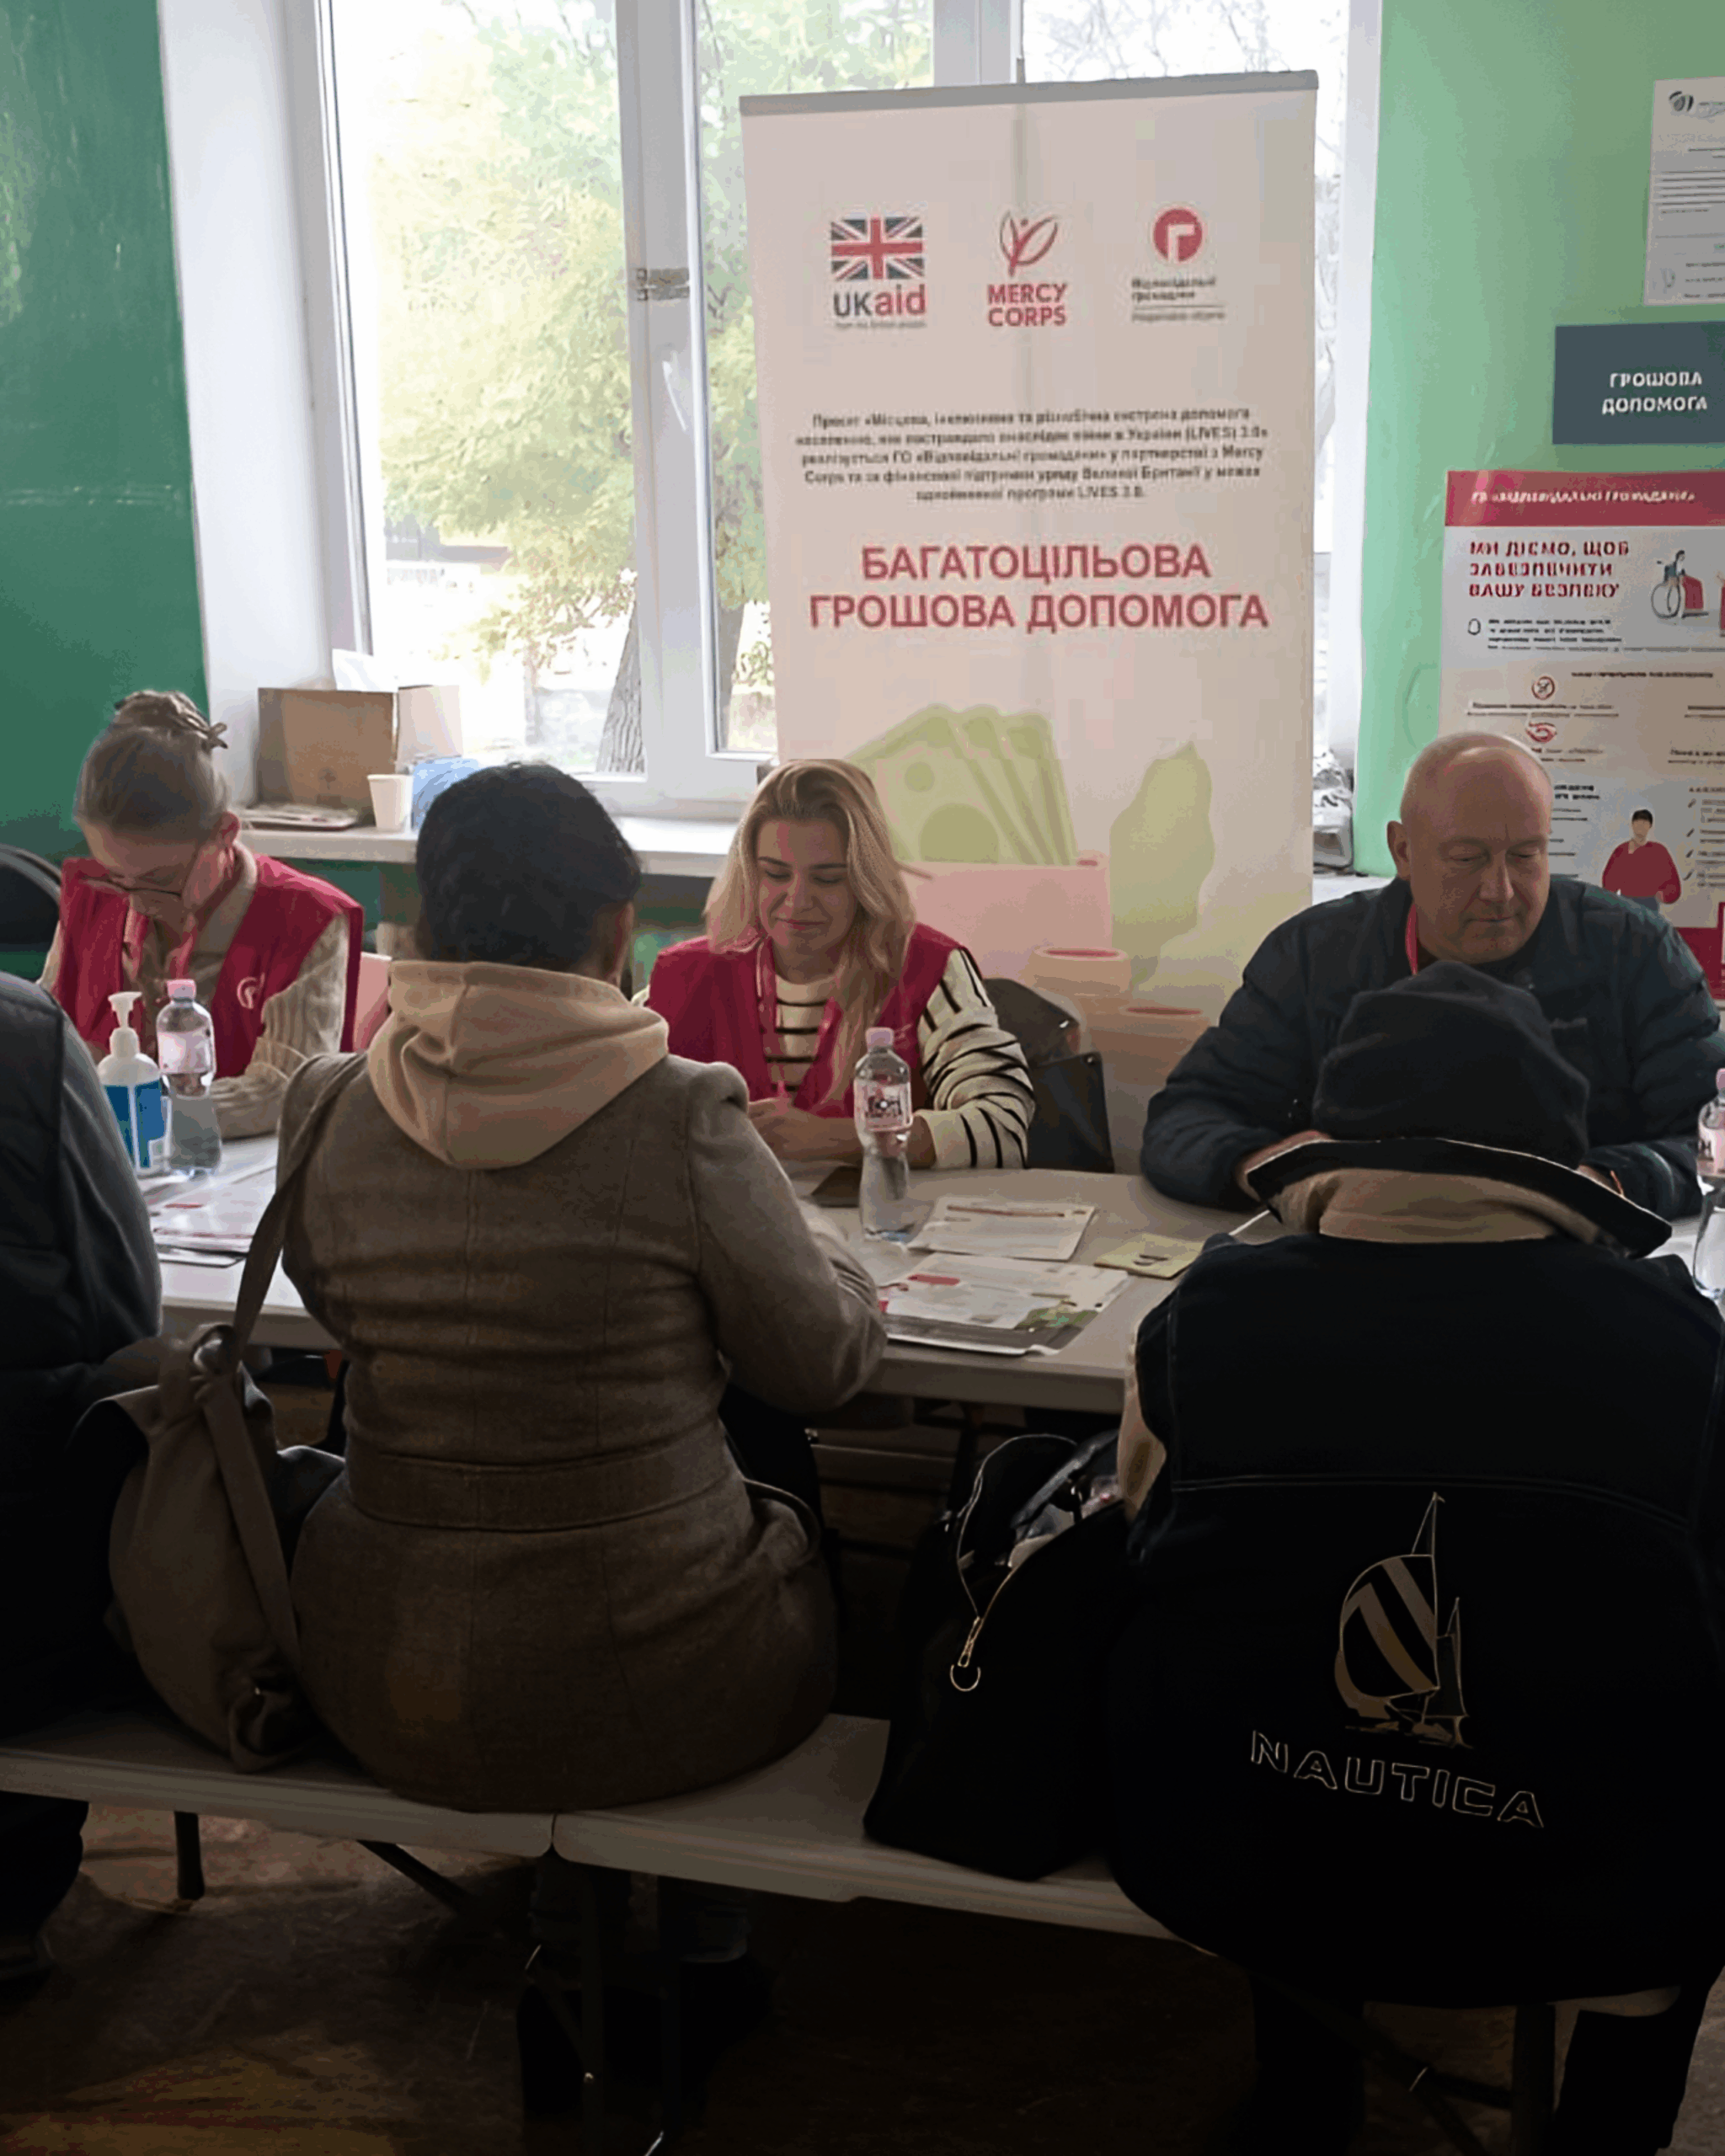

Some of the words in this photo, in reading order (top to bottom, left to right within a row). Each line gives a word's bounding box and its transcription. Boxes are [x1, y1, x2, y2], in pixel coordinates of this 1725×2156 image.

[833, 283, 927, 317] UKaid
[987, 283, 1068, 304] MERCY
[988, 306, 1066, 327] CORPS
[1610, 371, 1702, 387] ГРОШОВА
[1602, 396, 1707, 415] ДОПОМОГА
[894, 451, 911, 462] ГО
[1222, 445, 1263, 462] Mercy
[862, 543, 1210, 585] БАГАТОЦІЛЬОВА
[809, 594, 1016, 628] ГРОШОВА
[1027, 594, 1269, 634] ДОПОМОГА
[1252, 1729, 1544, 1828] NAUTICA
